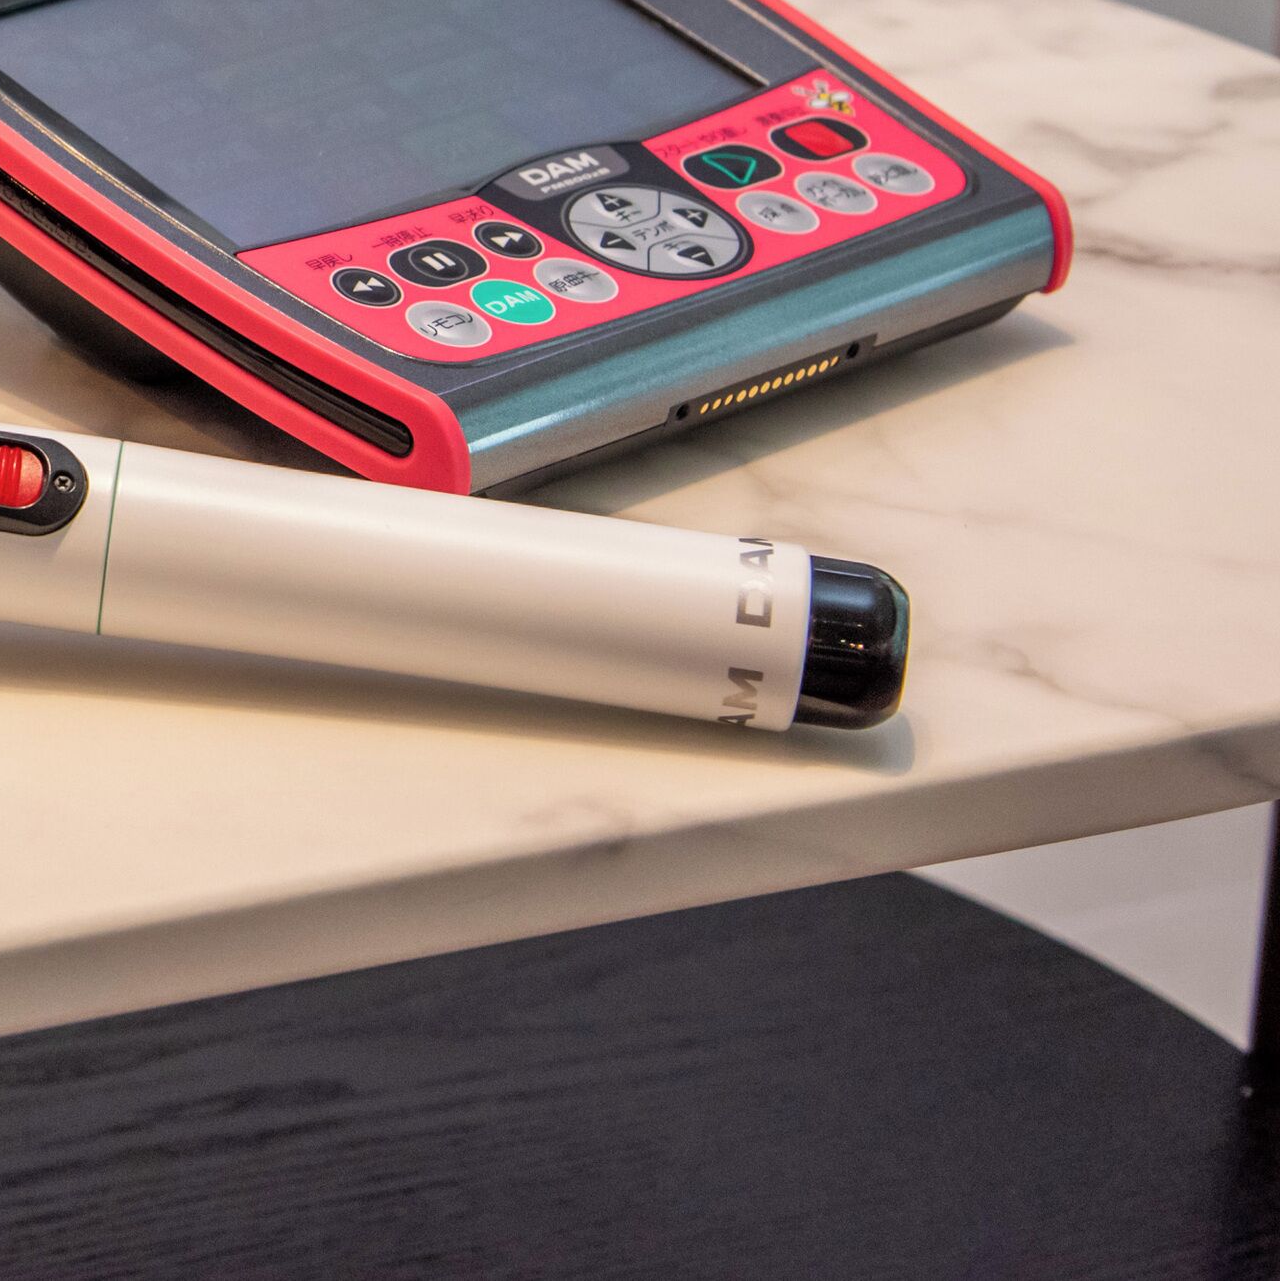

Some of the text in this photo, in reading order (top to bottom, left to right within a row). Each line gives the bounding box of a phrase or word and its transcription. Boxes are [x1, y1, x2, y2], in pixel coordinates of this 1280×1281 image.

[518, 152, 600, 186] DAM
[304, 253, 354, 271] 早戻し
[485, 290, 542, 315] DAM
[420, 313, 474, 337] リモコン
